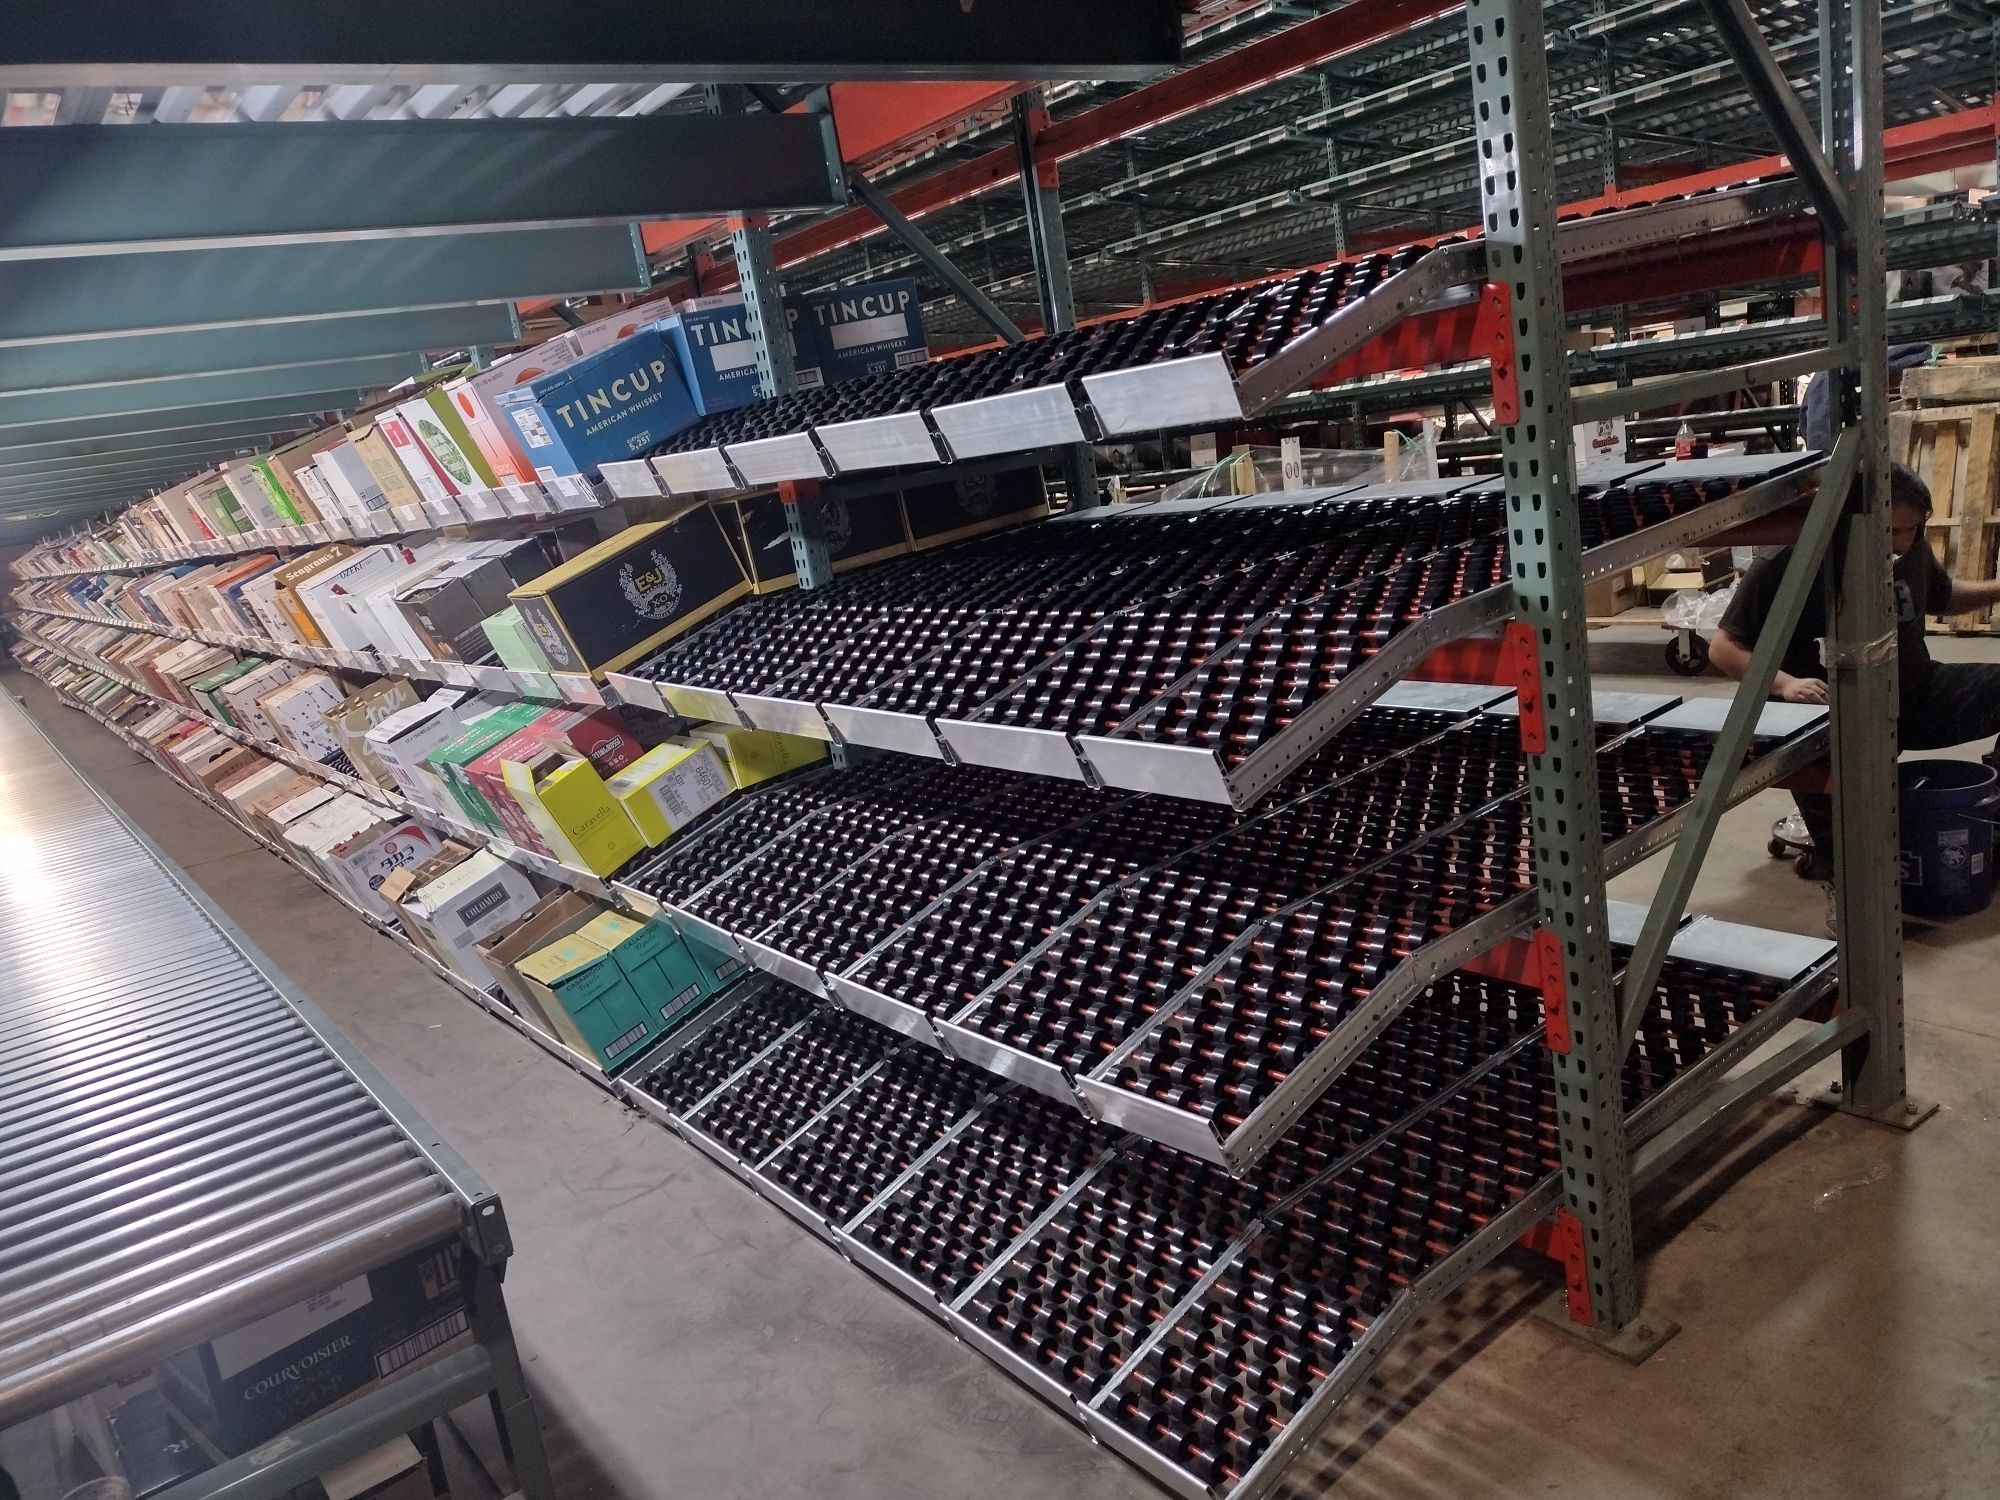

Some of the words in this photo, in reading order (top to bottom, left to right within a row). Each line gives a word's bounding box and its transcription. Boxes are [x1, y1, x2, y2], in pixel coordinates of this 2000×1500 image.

[813, 291, 910, 326] TINCUP
[838, 346, 875, 358] AMERICAN
[876, 340, 907, 352] WHISKEY
[556, 360, 665, 429] TINCUP
[586, 409, 628, 436] AMERICAN
[628, 391, 663, 415] WHISKEY
[330, 545, 342, 557] 7
[634, 567, 663, 593] E&J
[652, 594, 668, 608] XO
[572, 804, 612, 836] Caravella
[380, 844, 415, 870] タカラ
[465, 890, 503, 919] COLOMBO
[623, 923, 660, 950] CASAMIGOS
[243, 1334, 351, 1400] COURVOISIER
